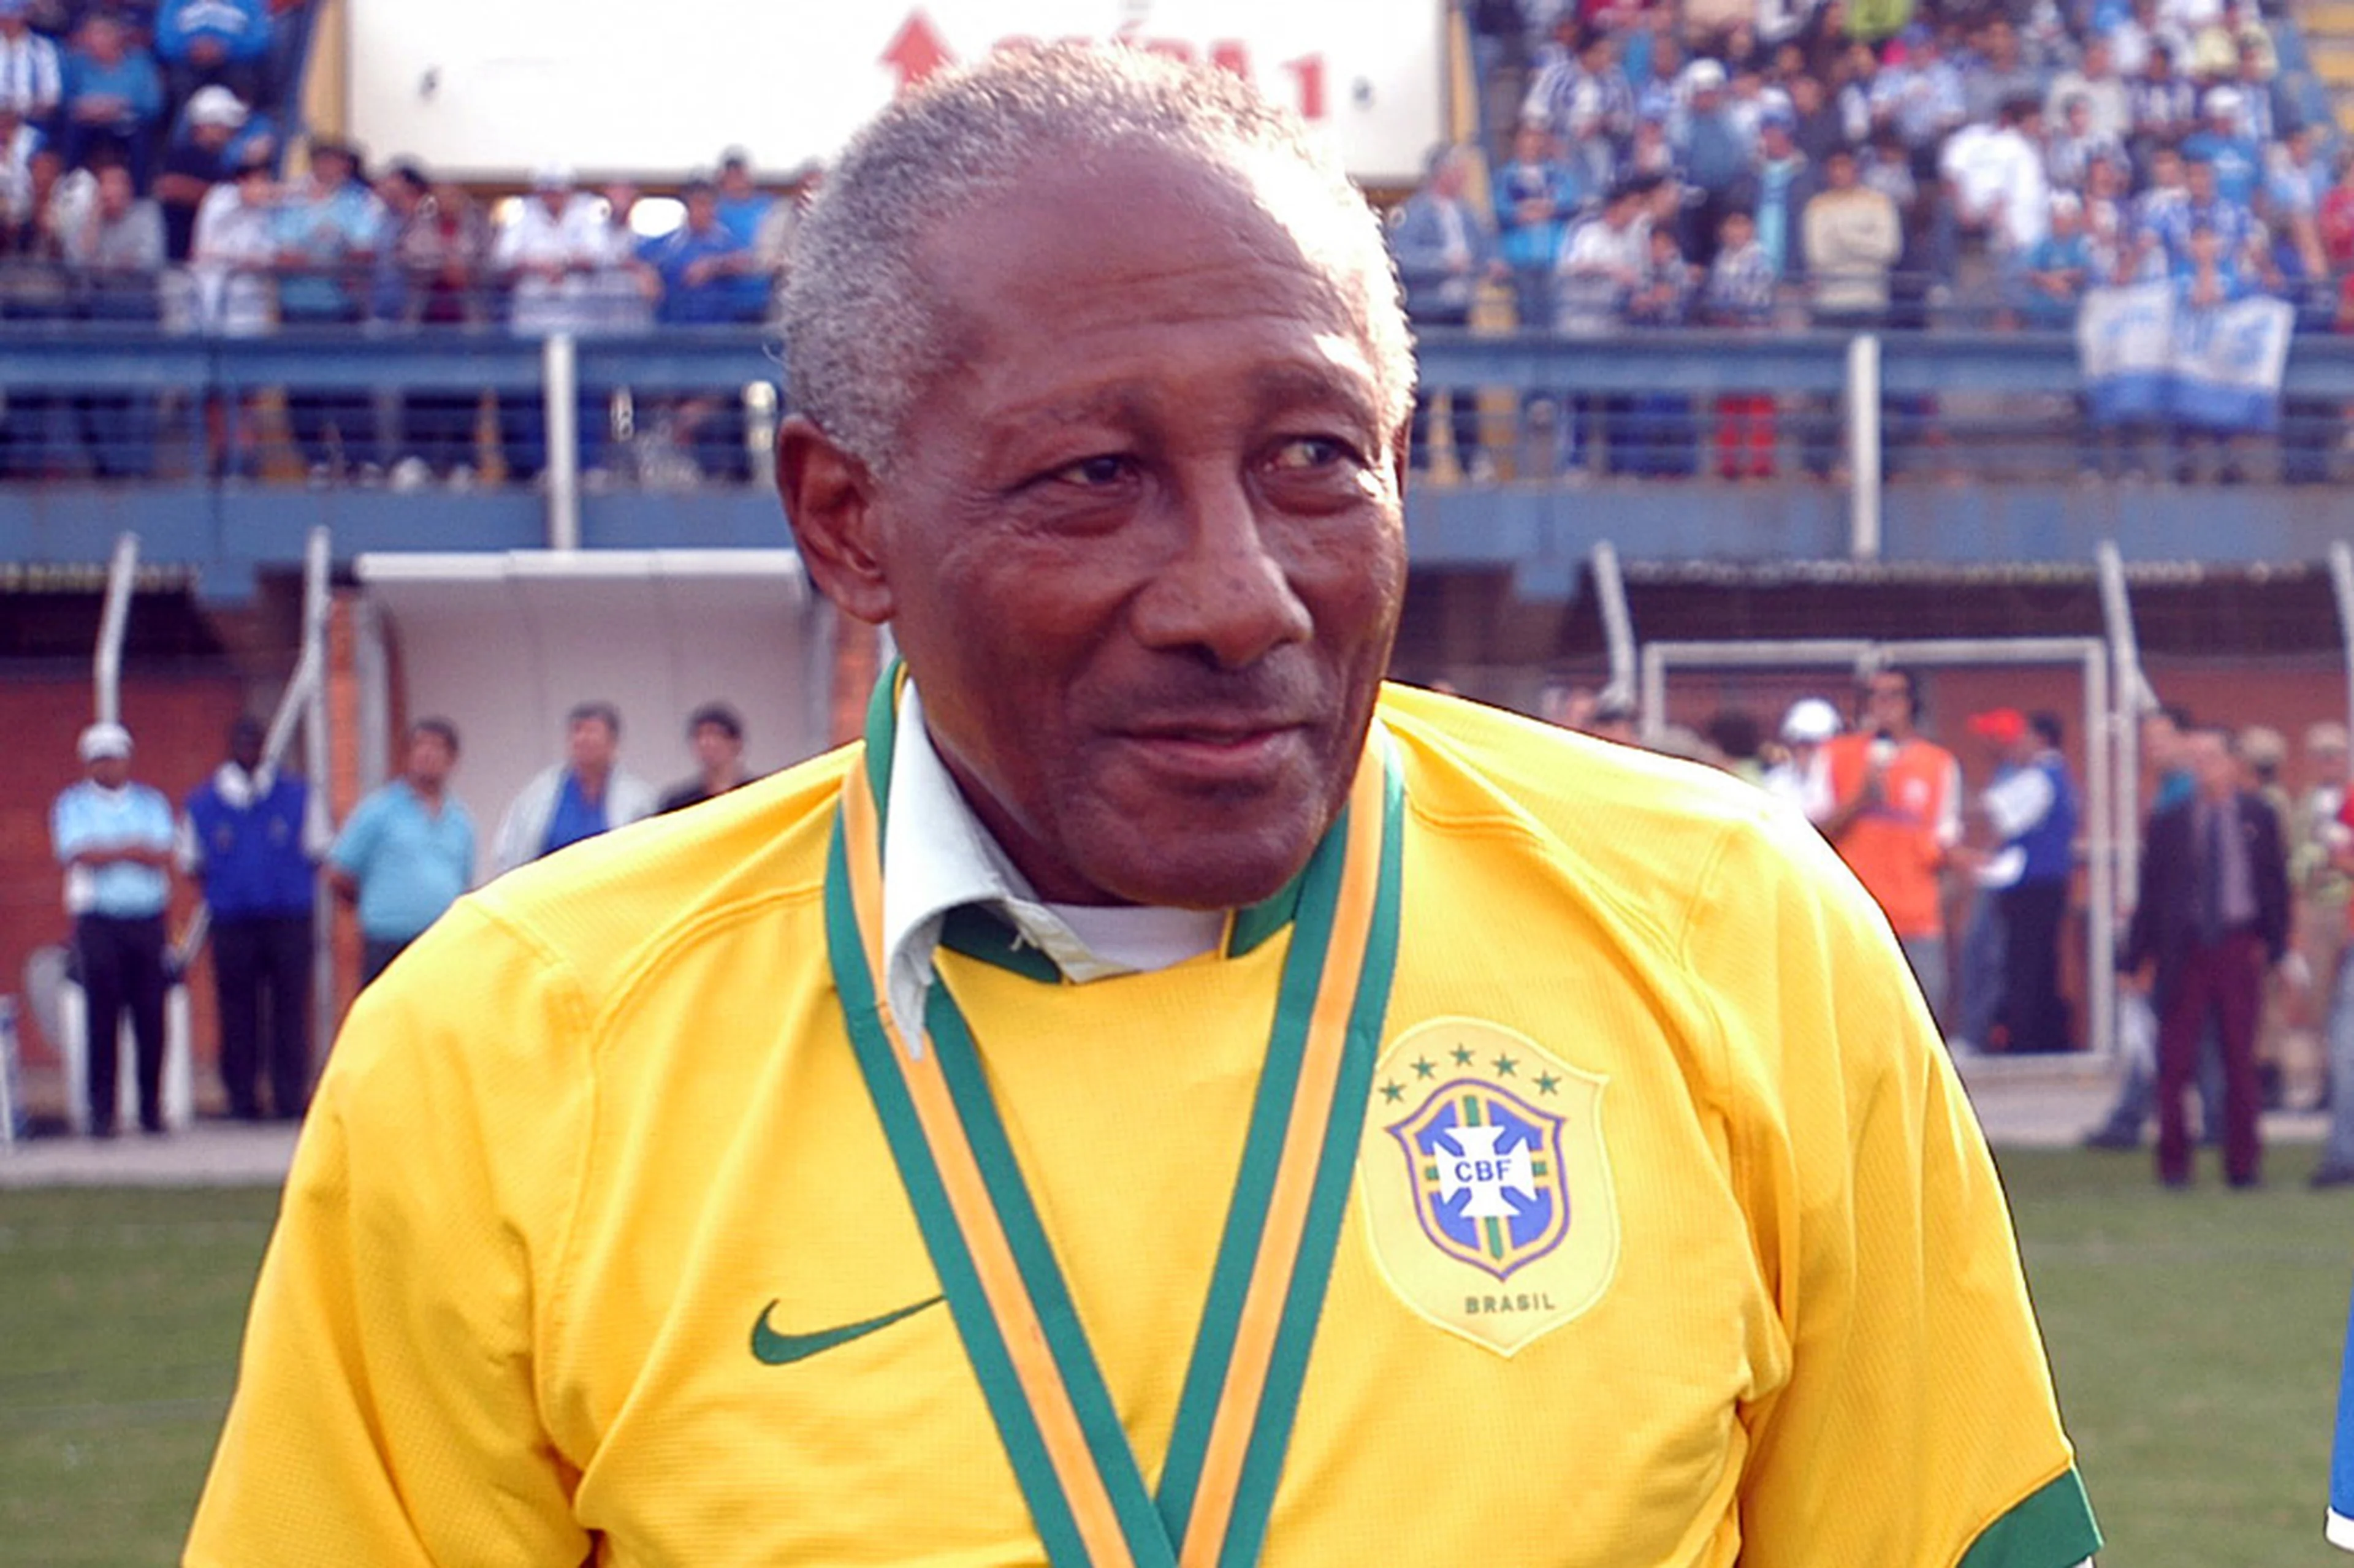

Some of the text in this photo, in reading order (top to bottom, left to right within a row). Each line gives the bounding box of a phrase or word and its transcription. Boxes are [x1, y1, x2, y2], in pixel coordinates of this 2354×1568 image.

[1284, 51, 1326, 121] 1
[1455, 1159, 1512, 1182] CBF
[1465, 1290, 1556, 1315] BRASIL
